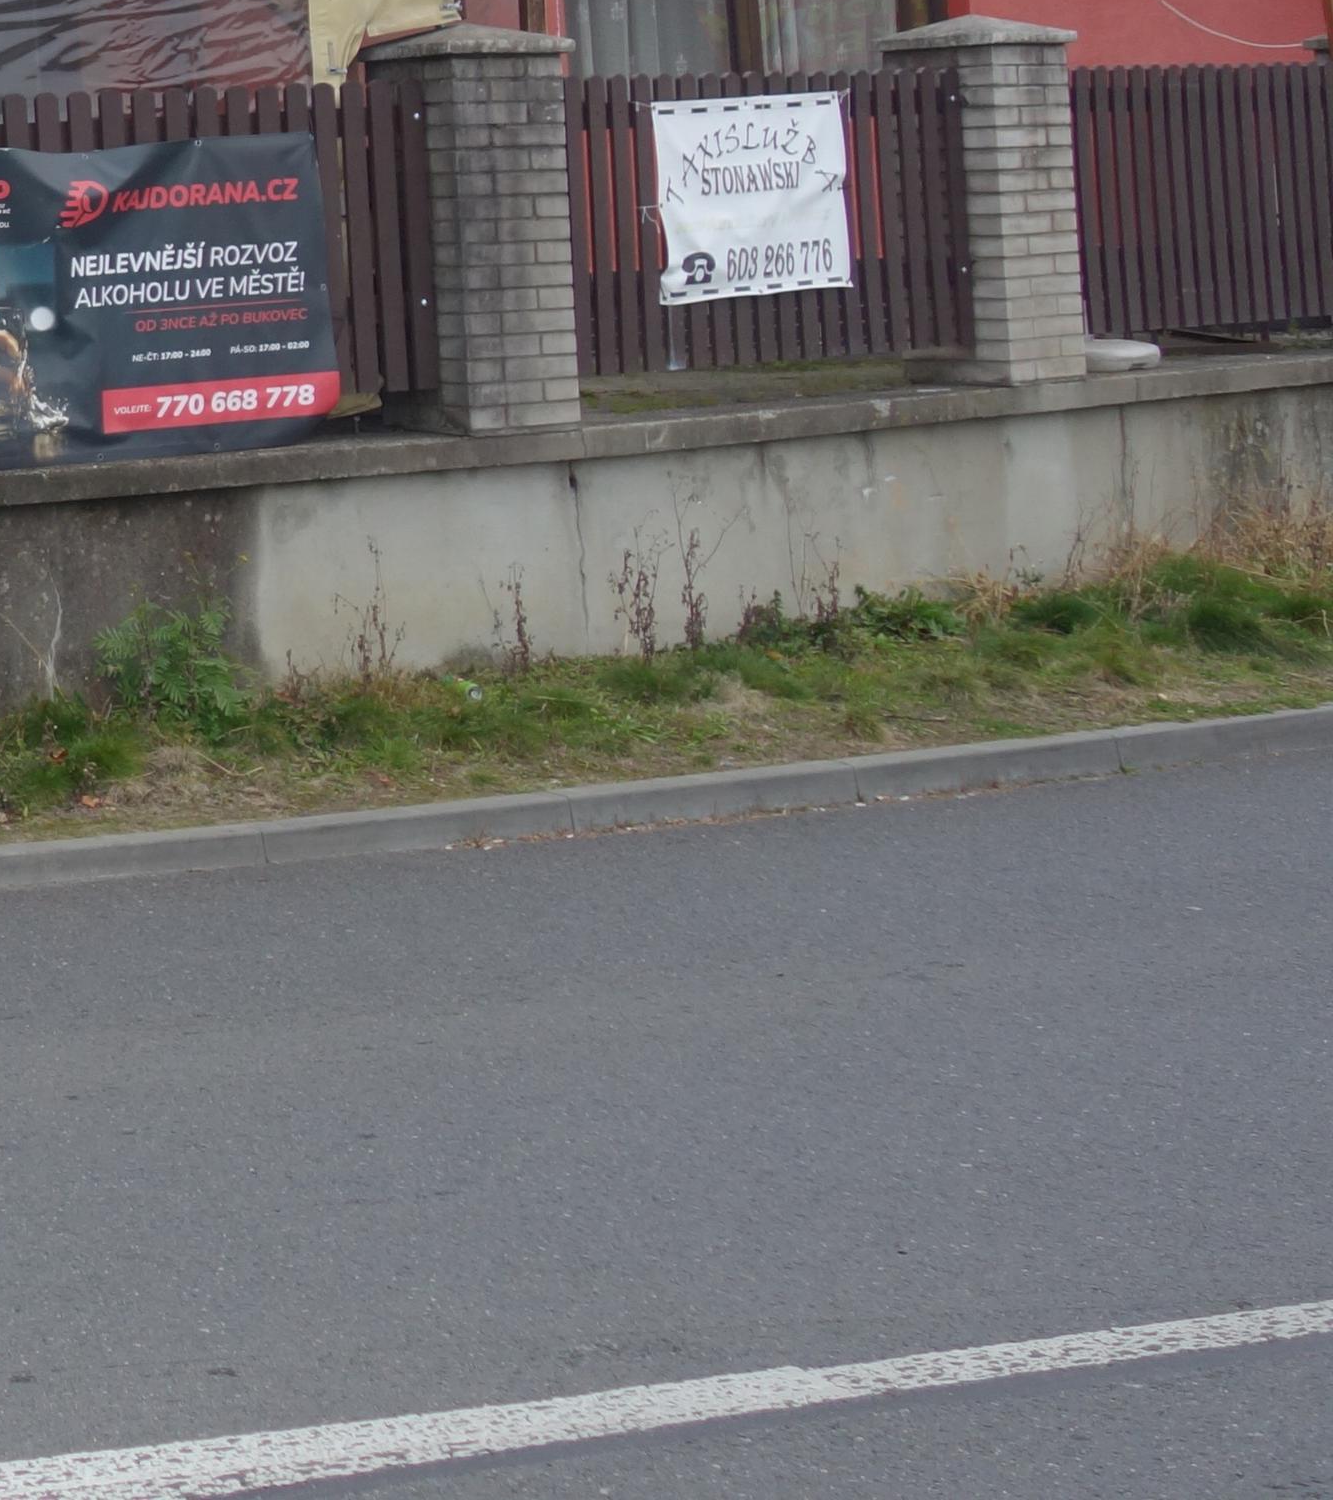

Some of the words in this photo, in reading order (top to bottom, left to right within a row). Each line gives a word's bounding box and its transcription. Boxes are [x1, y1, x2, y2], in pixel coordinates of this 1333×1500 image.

[700, 157, 801, 196] STONAWSKI
[113, 178, 299, 213] KAJDORANA.CZ
[70, 242, 205, 278] NEJLEVNĚJŠÍ
[209, 241, 298, 267] ROZVOZ
[727, 245, 758, 282] 603
[763, 242, 796, 278] 266
[801, 238, 833, 275] 776
[74, 279, 190, 309] ALKOHOLU
[196, 276, 224, 299] VE
[229, 266, 305, 297] MĚSTĚ!
[135, 319, 156, 333] OD
[199, 312, 217, 327] AŽ
[221, 312, 239, 325] PO
[243, 308, 308, 323] BUKOVEC
[114, 404, 152, 415] VOLEJTE:
[157, 393, 205, 418] 770
[211, 389, 257, 414] 668
[265, 384, 315, 409] 778
